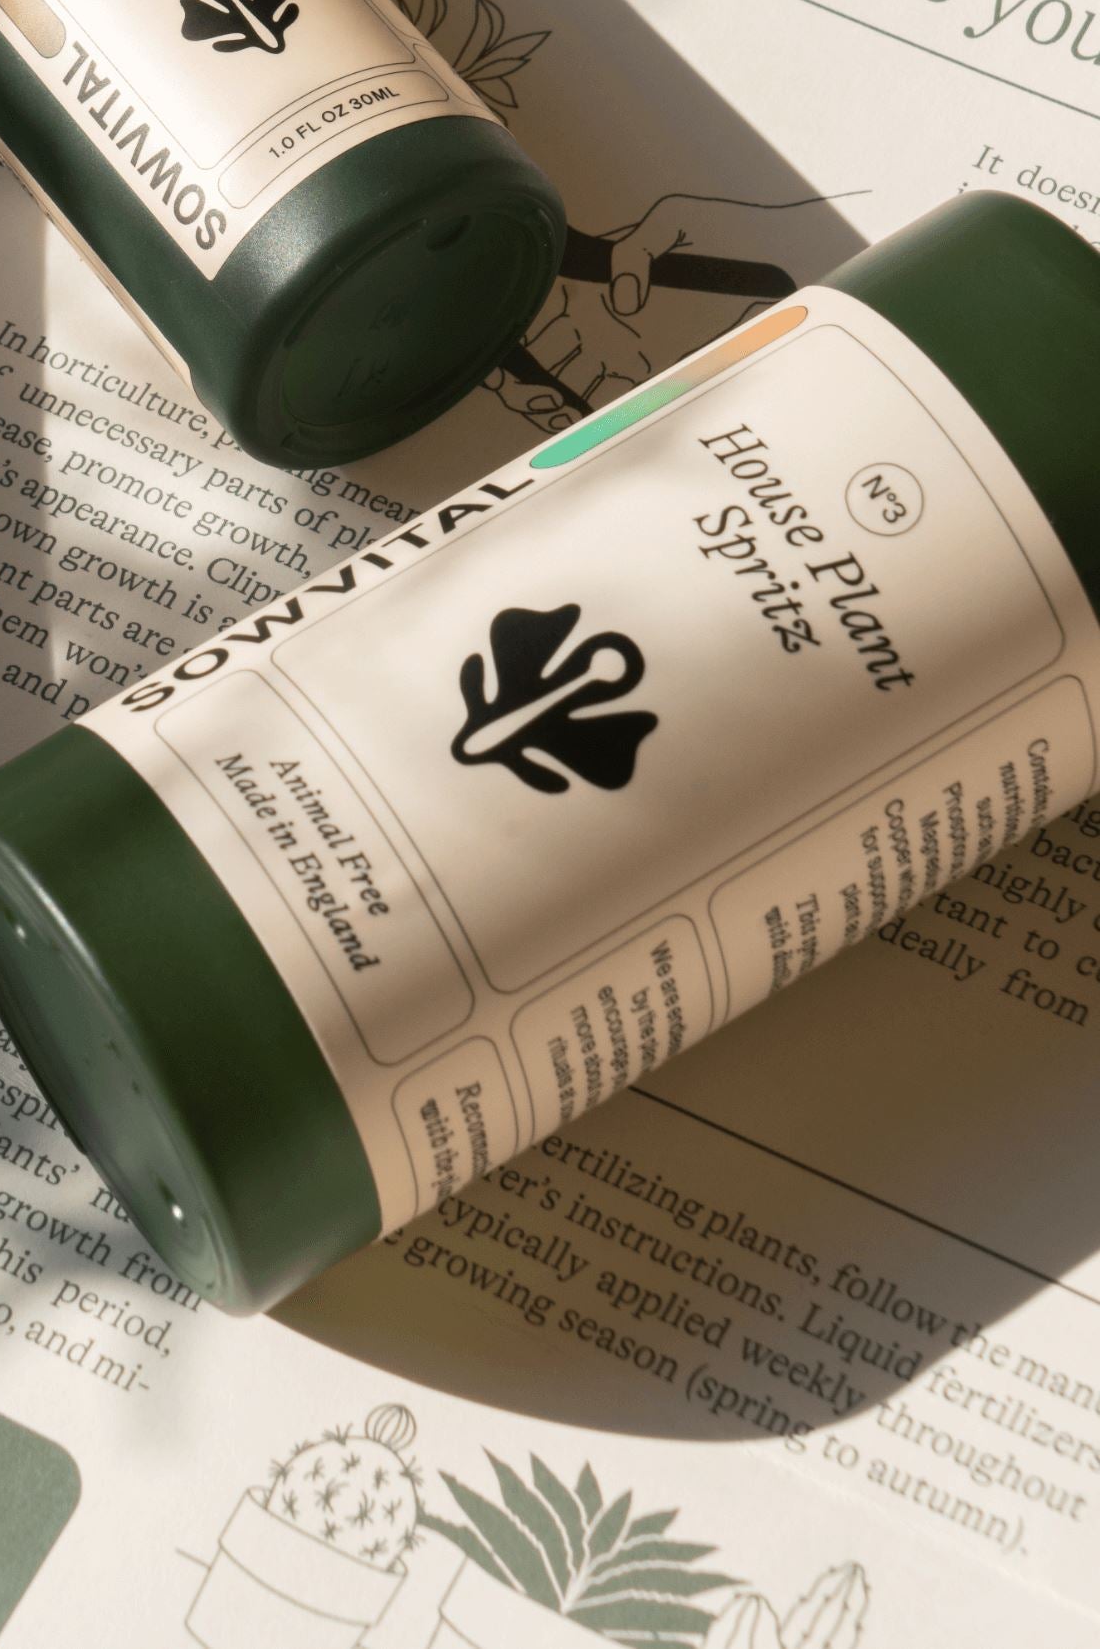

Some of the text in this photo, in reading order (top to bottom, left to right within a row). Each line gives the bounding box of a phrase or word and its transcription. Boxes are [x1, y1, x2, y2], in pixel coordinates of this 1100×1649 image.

[62, 41, 227, 250] SOWVITAL
[269, 87, 400, 158] 1.0 FL OZ 30ML
[18, 382, 287, 514] unnecessary parts
[26, 335, 211, 439] horticulture,
[19, 478, 193, 570] appearance.
[58, 450, 192, 518] promote
[192, 511, 313, 582] growth,
[58, 546, 177, 610] growth
[693, 505, 821, 654] Spritz
[698, 423, 915, 691] House Plant
[28, 580, 119, 630] parts
[122, 479, 535, 711] SOWVITAL
[215, 754, 380, 971] Made in England
[269, 761, 390, 916] Animal Free
[1001, 968, 1089, 1026] from
[50, 1279, 171, 1357] period,
[564, 1192, 1100, 1469] instructions. Liquid fertilizers
[697, 1209, 947, 1336] plants, follow
[402, 1235, 1025, 1553] growing season (spring autumn).
[595, 1270, 732, 1350] applied
[741, 1335, 865, 1419] weekly
[876, 1393, 1085, 1519] throughout
